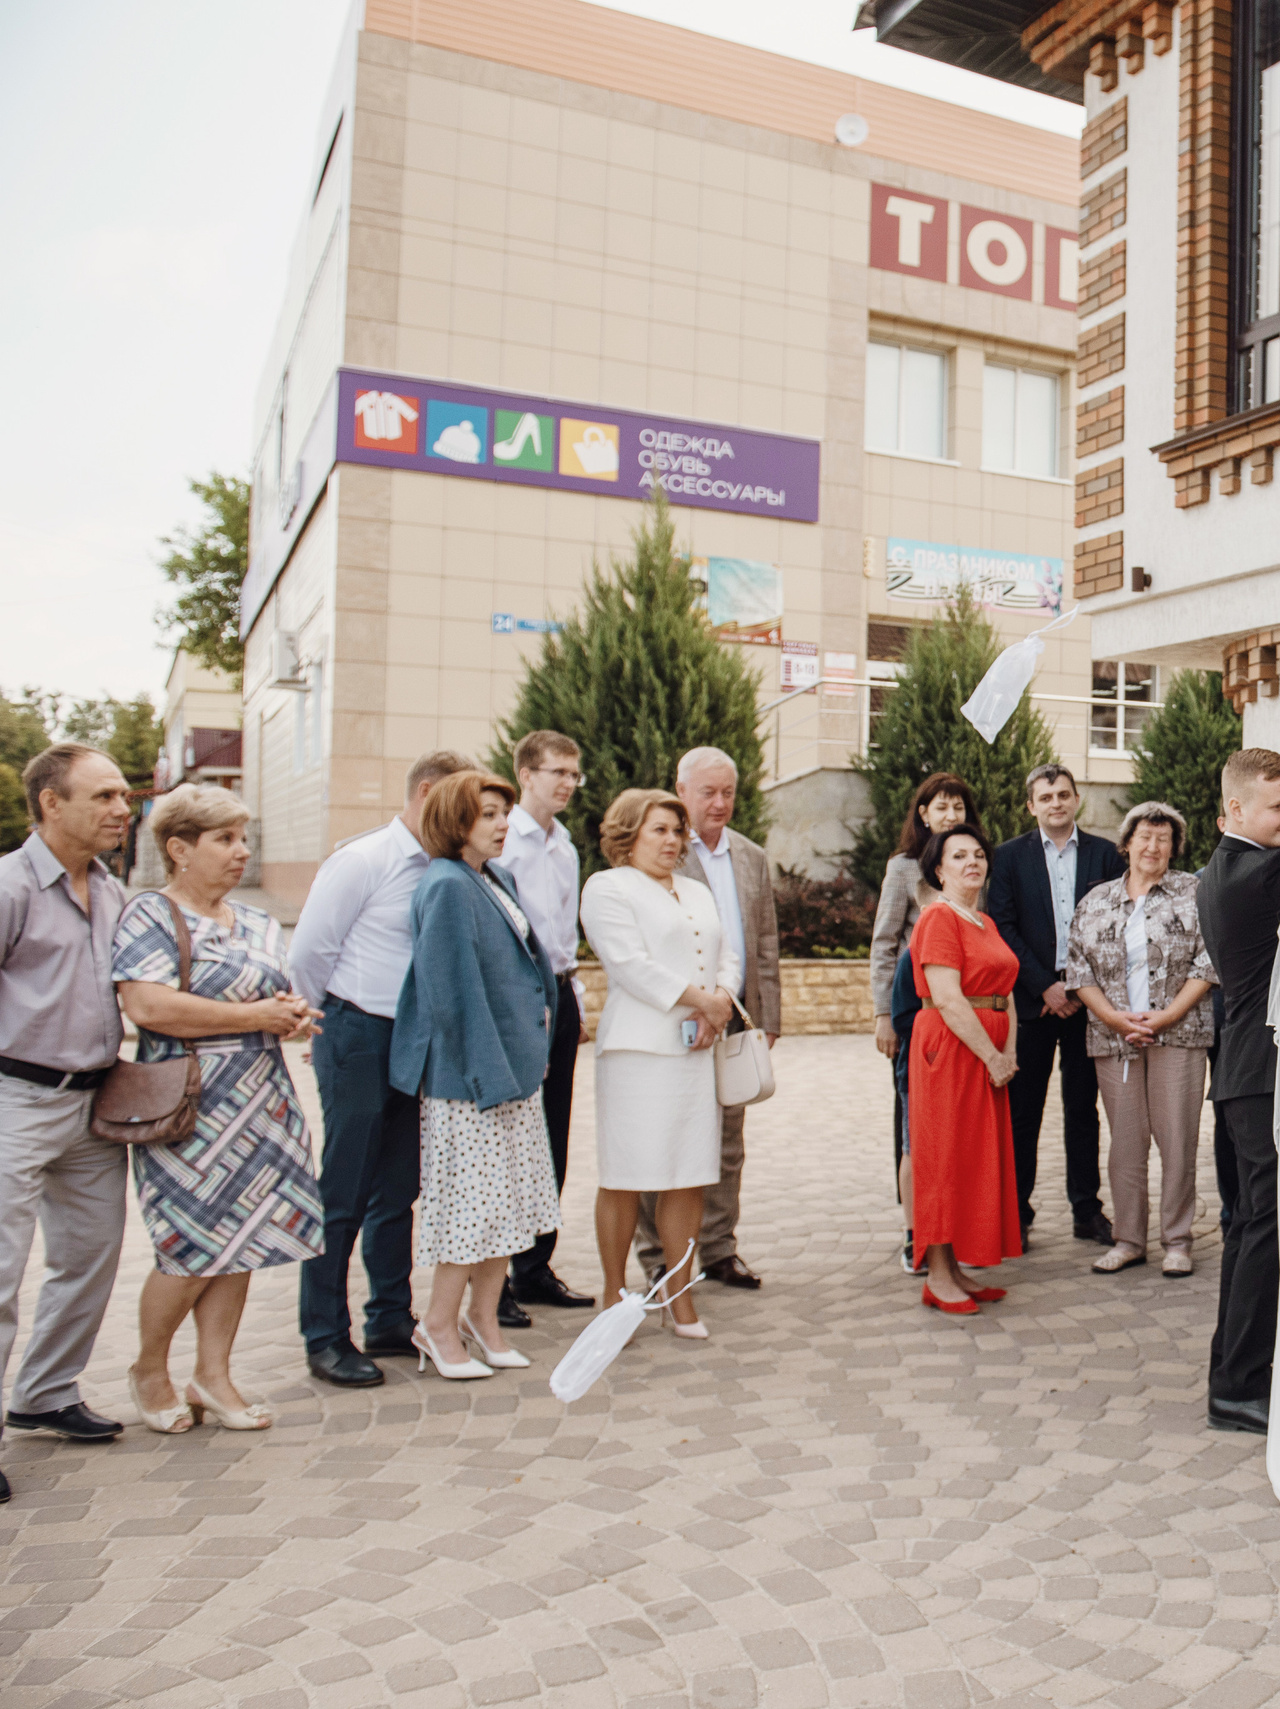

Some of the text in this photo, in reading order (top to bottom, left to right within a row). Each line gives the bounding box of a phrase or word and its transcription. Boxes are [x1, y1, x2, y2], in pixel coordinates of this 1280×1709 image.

[639, 428, 735, 460] ОДЕЖДА
[638, 450, 711, 476] ОБУВЬ
[638, 470, 786, 506] АКСЕССУАРЫ
[891, 546, 1035, 580] С ПРАЗДНИКОМ
